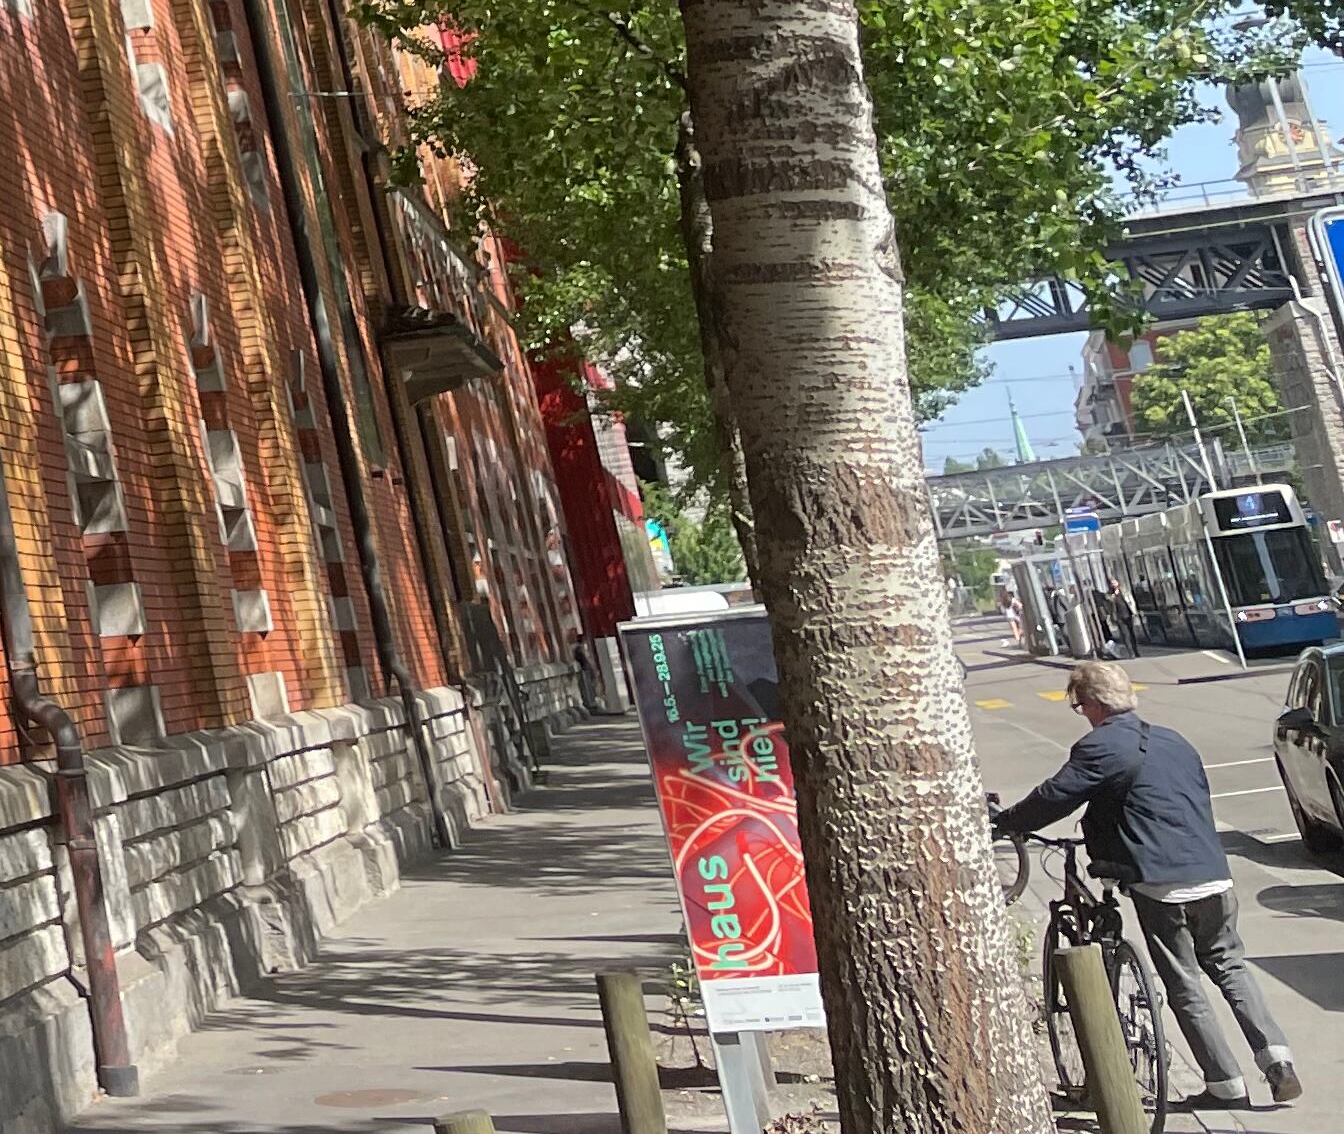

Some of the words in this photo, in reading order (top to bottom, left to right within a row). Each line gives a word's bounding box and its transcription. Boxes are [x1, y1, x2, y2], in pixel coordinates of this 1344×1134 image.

[682, 721, 715, 774] Wir
[710, 719, 750, 782] sind
[740, 717, 781, 782] hier!
[698, 853, 748, 969] haus
